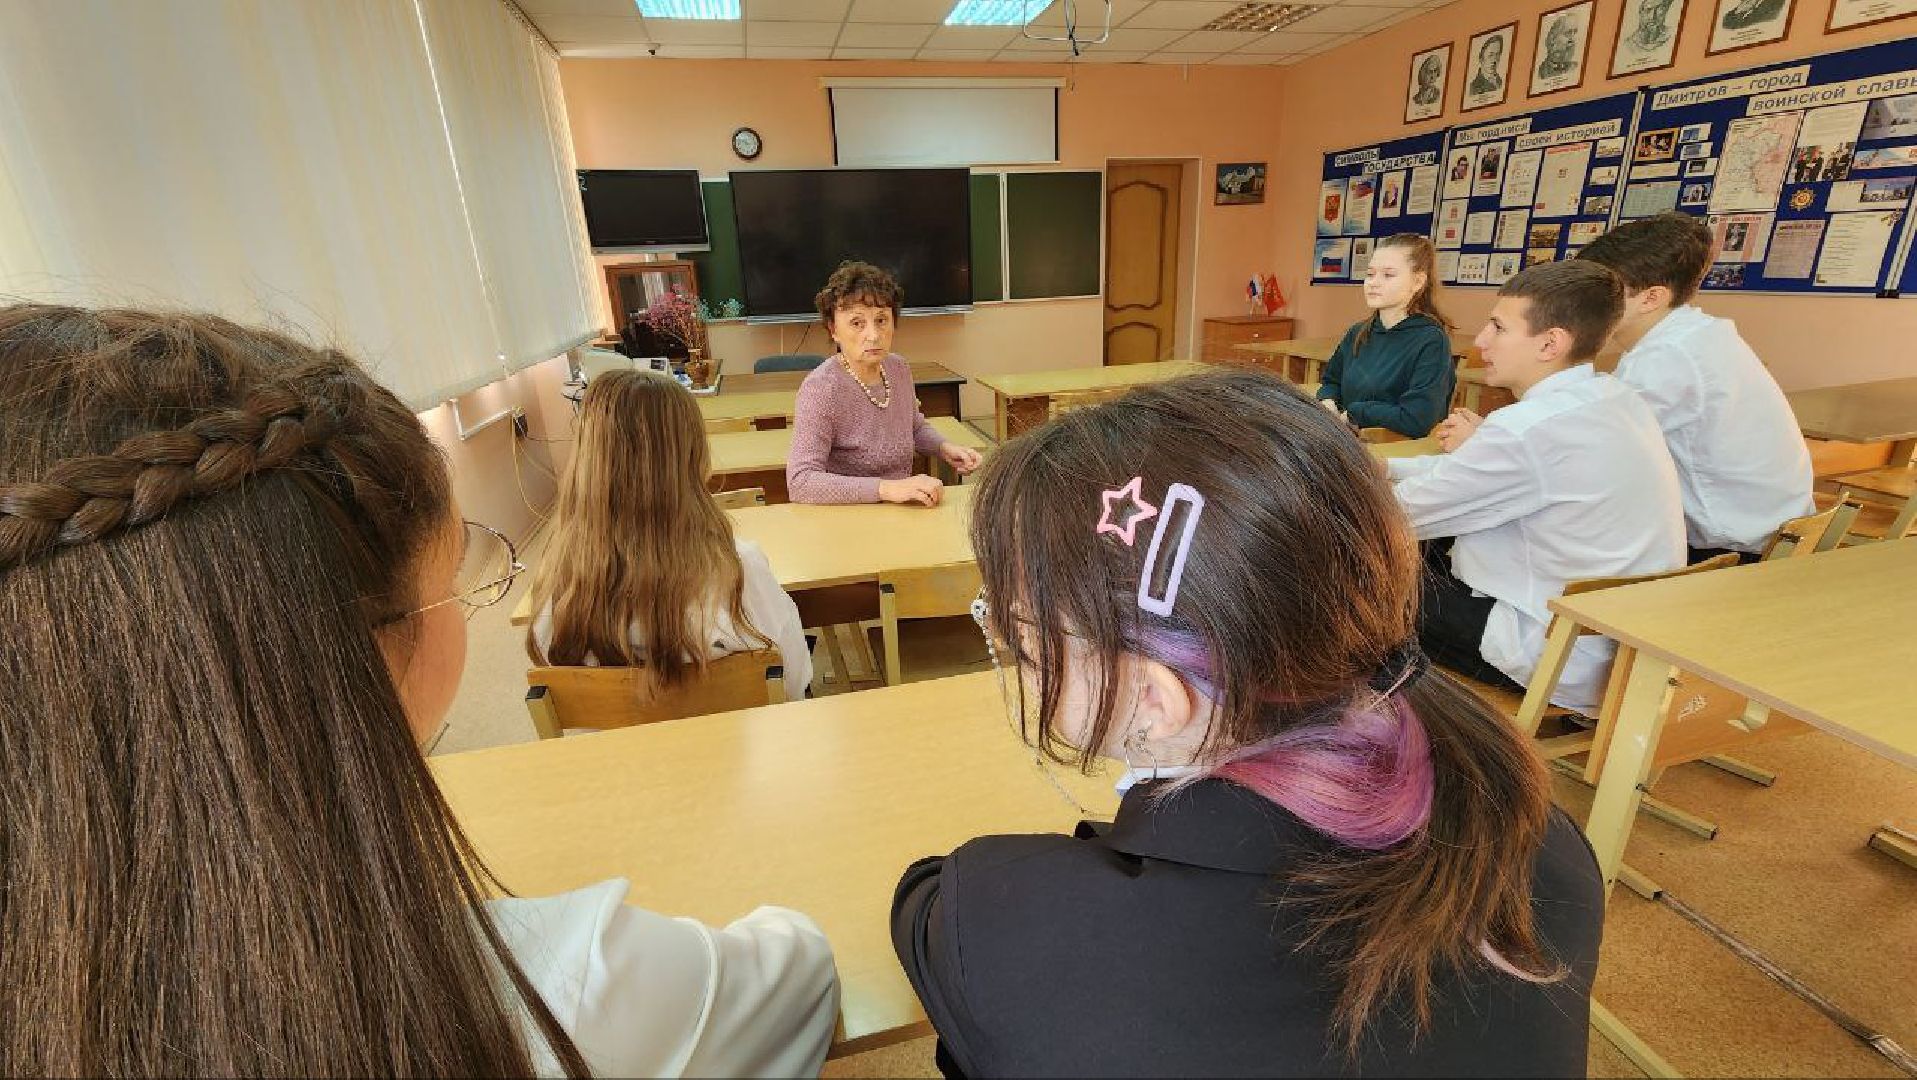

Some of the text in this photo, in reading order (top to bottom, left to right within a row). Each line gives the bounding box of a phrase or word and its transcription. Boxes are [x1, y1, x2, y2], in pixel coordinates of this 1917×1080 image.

[1656, 85, 1728, 107] Дмитров
[1749, 72, 1803, 92] город
[1752, 86, 1846, 111] воинской
[1479, 123, 1528, 139] гордимся
[1556, 122, 1616, 142] историей
[1364, 154, 1434, 173] ГОСУДАРСТВА
